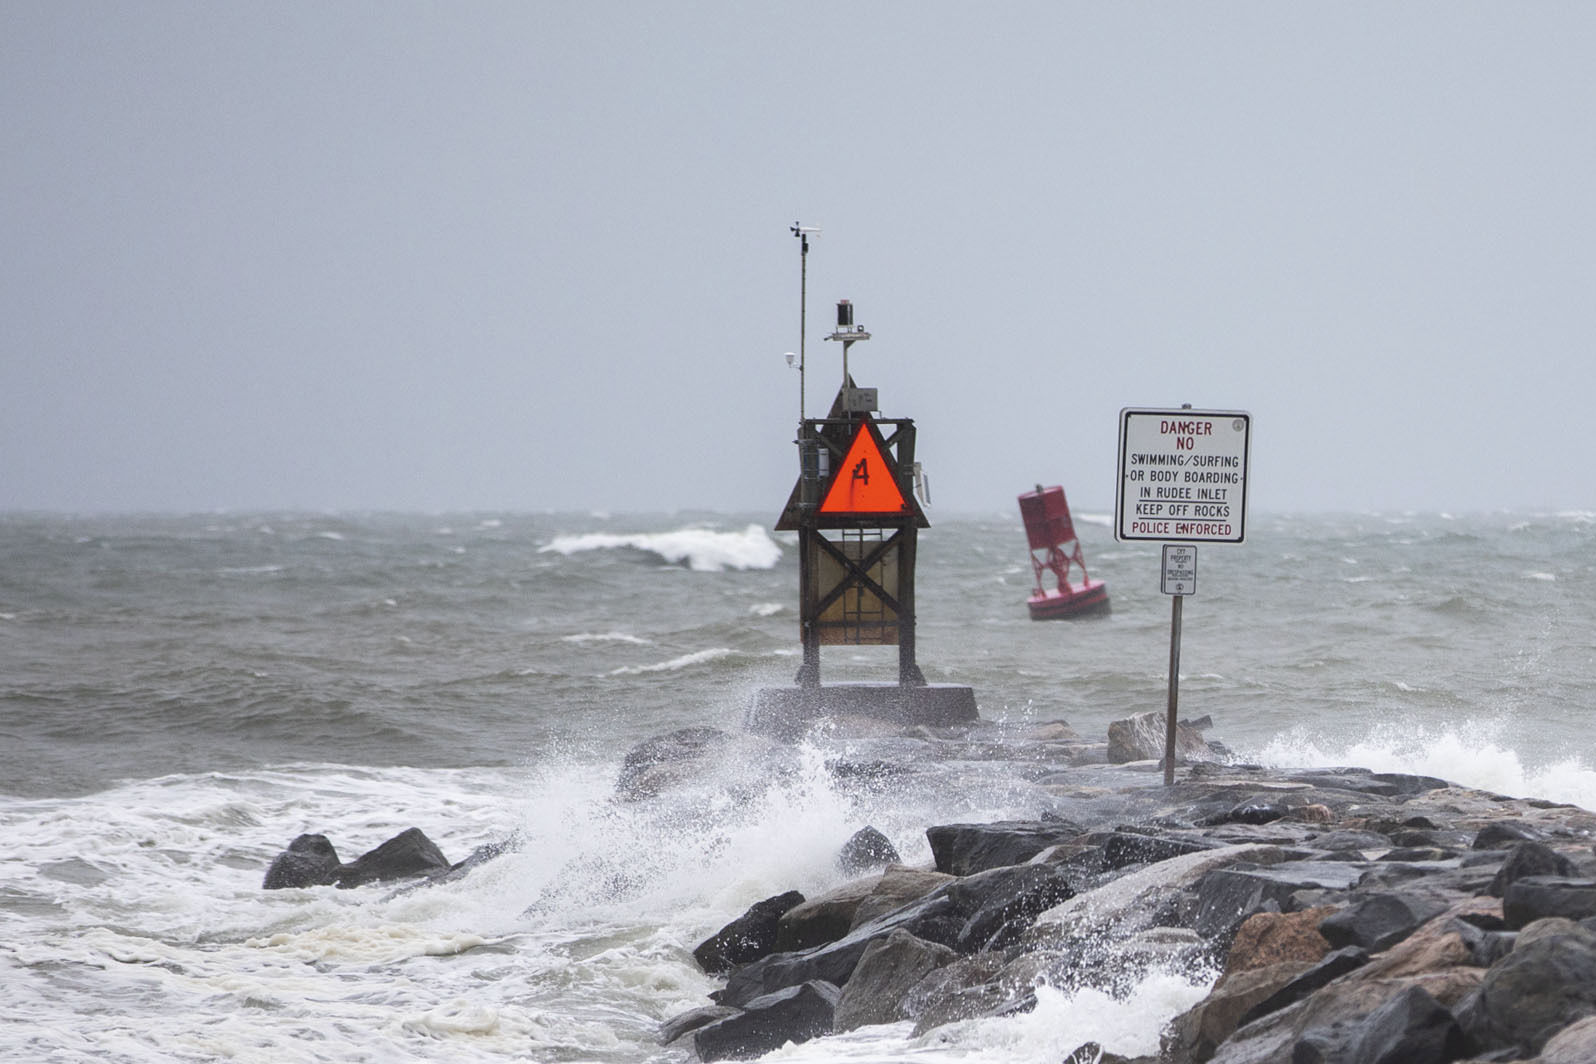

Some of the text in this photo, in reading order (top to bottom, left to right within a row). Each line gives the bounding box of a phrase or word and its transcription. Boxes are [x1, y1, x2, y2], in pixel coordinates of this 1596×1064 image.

[1160, 421, 1212, 435] DANGER
[1176, 437, 1194, 450] NO
[1131, 453, 1239, 468] SWIMMING/SURFING
[1130, 470, 1239, 484] OR BODY BOARDING
[1140, 487, 1228, 500] IN RUDEE INLET
[1136, 504, 1230, 517] KEEP OFF ROCKS
[1132, 522, 1232, 536] POLICE ENFORCED
